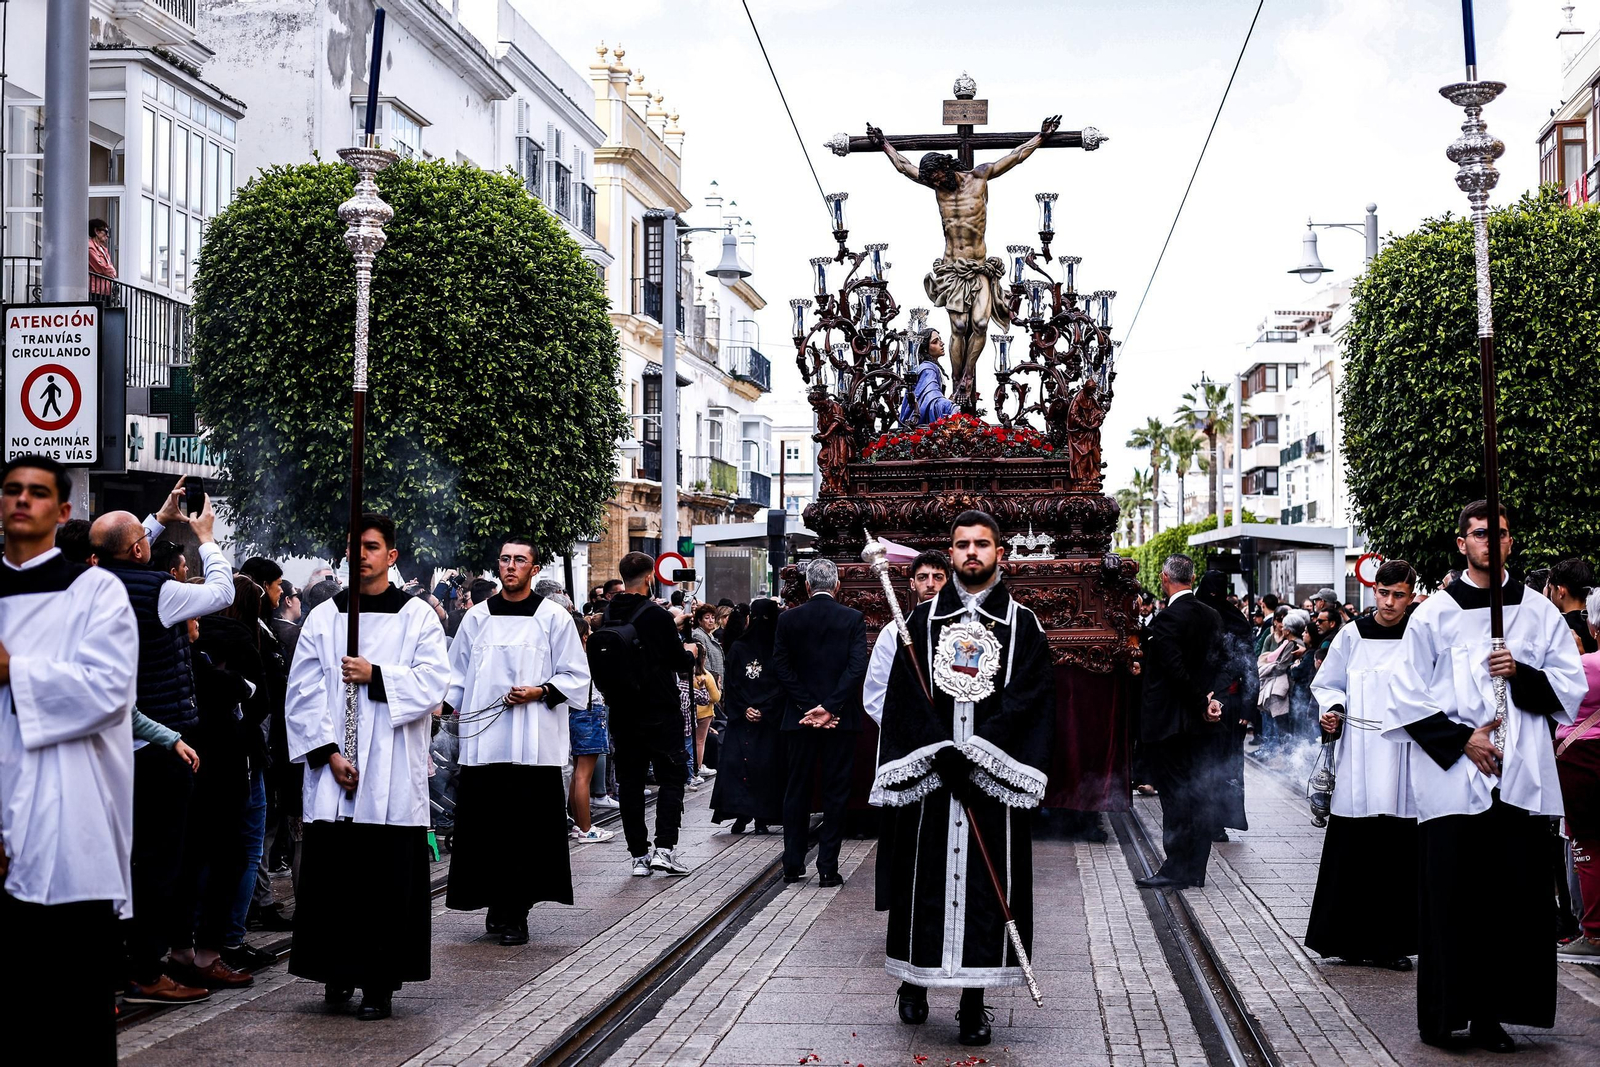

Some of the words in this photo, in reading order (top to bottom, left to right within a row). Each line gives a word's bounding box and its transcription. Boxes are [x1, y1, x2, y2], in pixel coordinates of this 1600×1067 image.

[10, 310, 94, 328] ATENCIÓN
[22, 331, 82, 344] TRANVÍAS
[12, 347, 91, 358] CIRCULANDO
[12, 437, 29, 447] NO
[34, 436, 90, 447] CAMINAR
[65, 447, 93, 459] VÍAS
